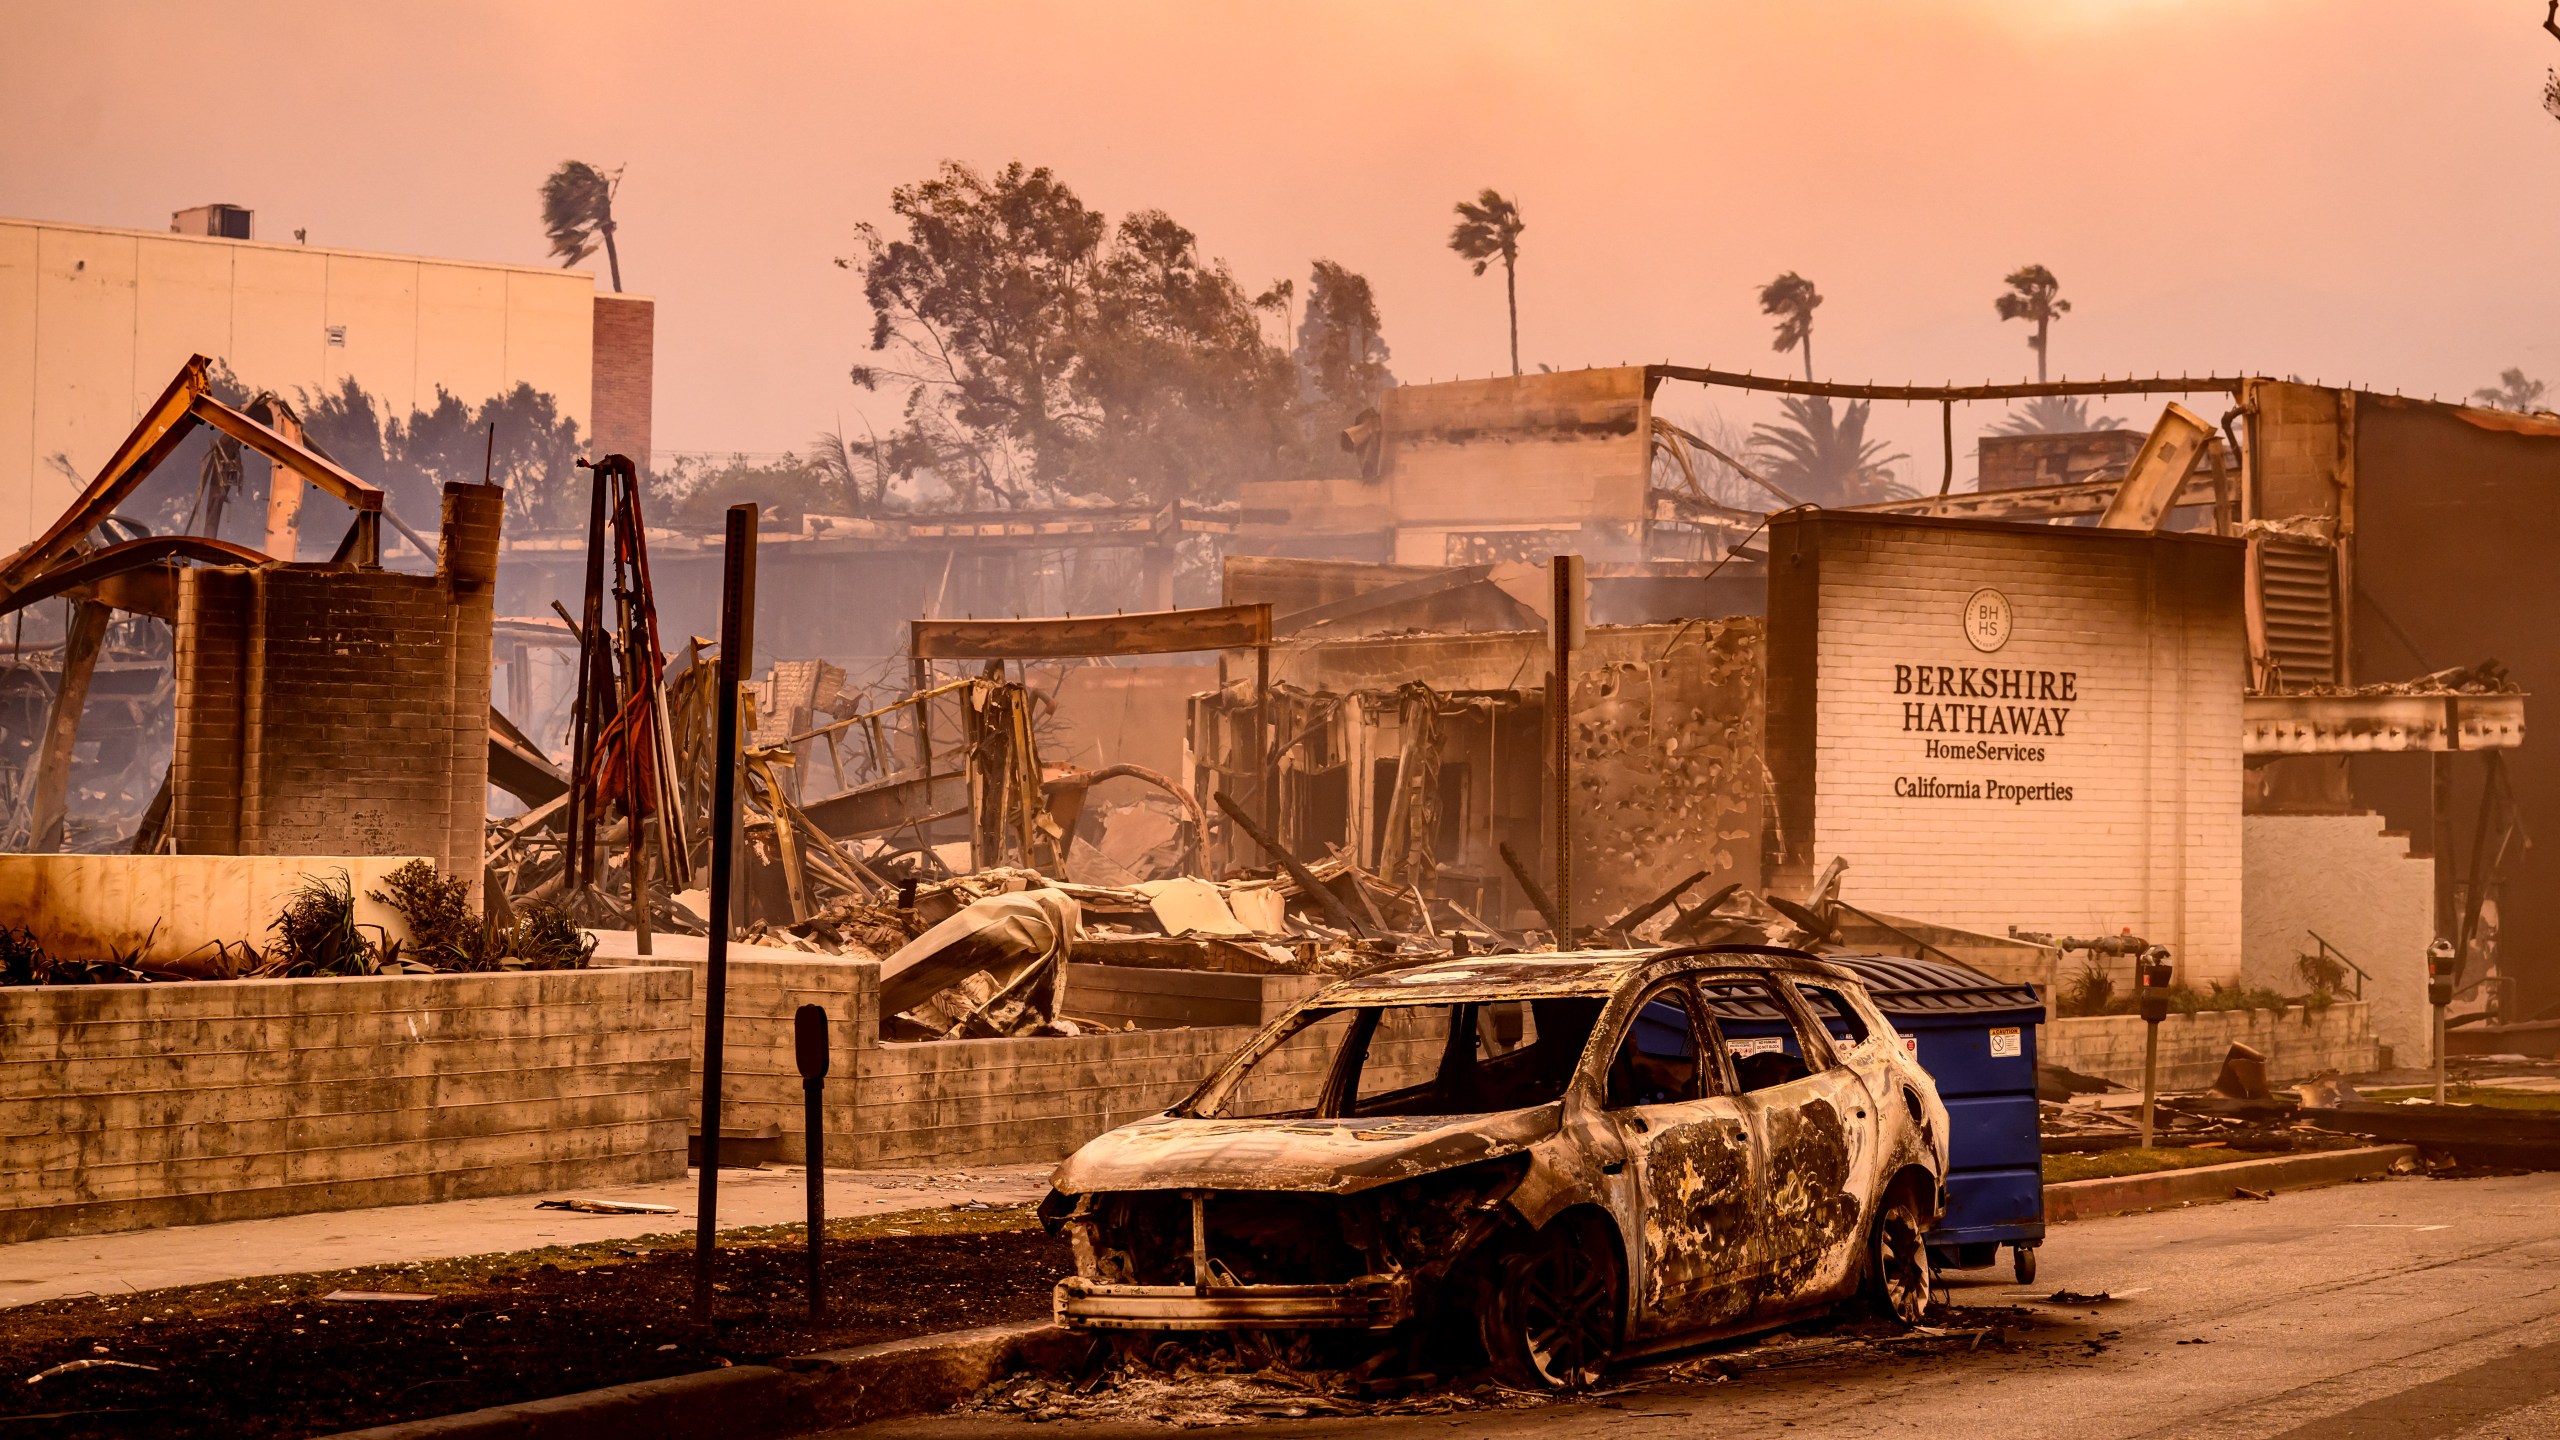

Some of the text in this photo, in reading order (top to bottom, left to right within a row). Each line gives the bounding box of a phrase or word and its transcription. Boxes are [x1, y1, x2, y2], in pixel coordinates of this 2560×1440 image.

[1979, 605, 1998, 620] BH
[1978, 621, 1998, 636] HS
[1893, 664, 2078, 701] BERKSHIRE
[1902, 702, 2071, 737] HATHAWAY
[1925, 739, 2046, 762] HomeServices
[1894, 776, 2073, 805] California Properties
